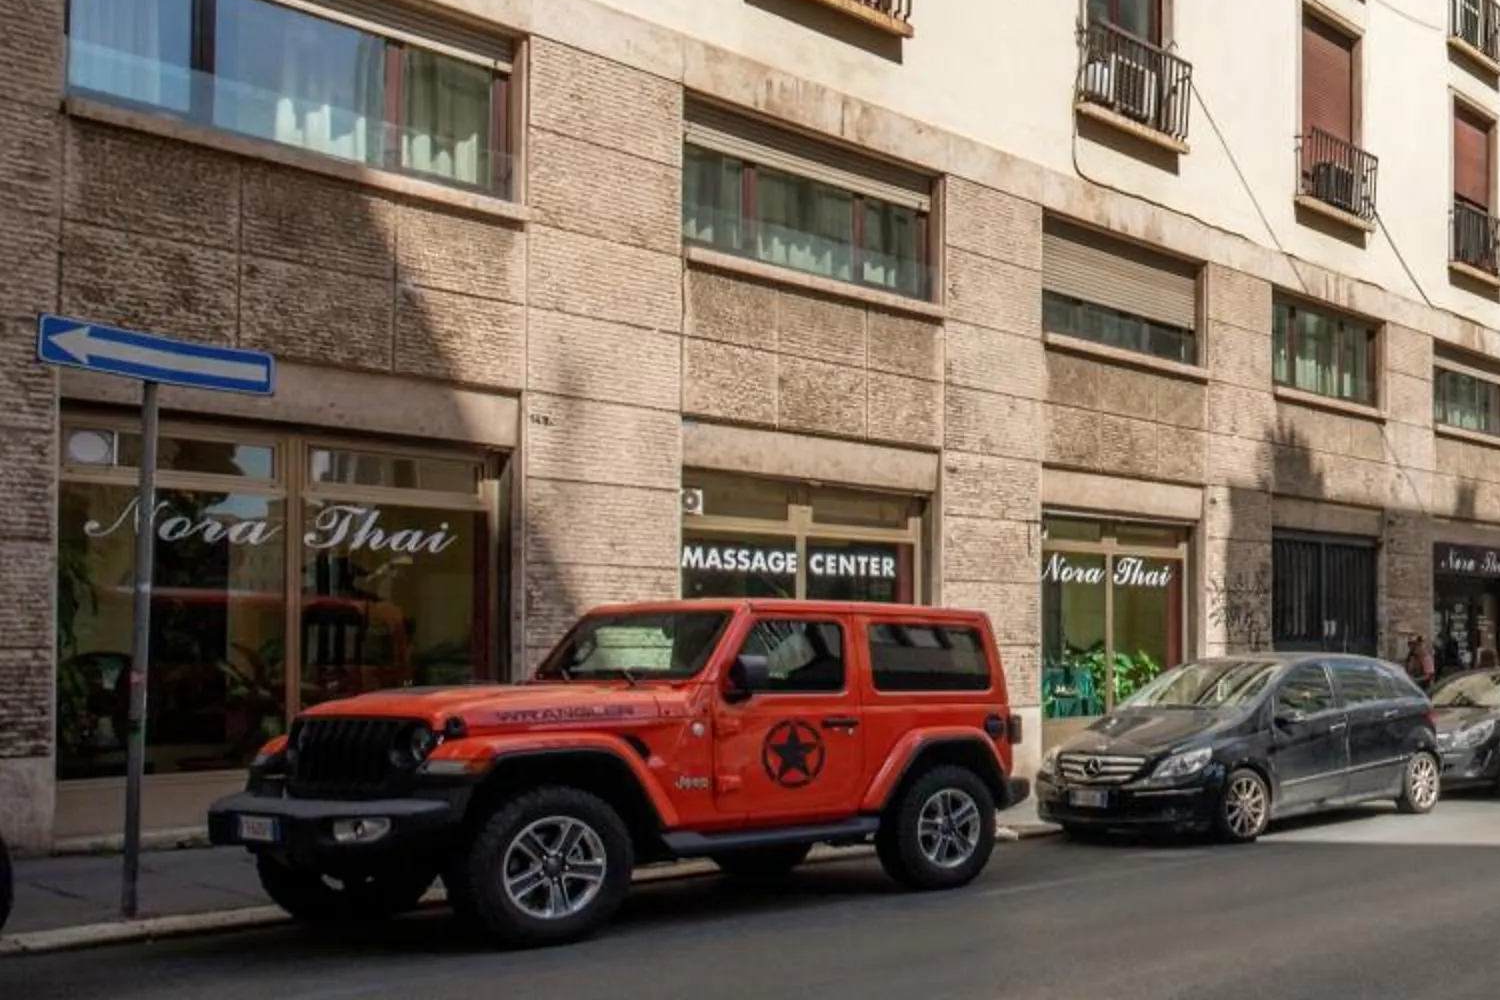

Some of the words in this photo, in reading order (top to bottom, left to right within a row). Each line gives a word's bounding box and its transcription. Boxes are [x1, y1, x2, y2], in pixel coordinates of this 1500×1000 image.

[83, 495, 281, 546] Nora
[303, 503, 458, 554] Thai
[681, 544, 799, 574] MASSAGE
[809, 553, 896, 578] CENTER
[1040, 551, 1105, 584] Nora
[1113, 556, 1172, 587] Thai
[496, 704, 635, 722] WRANGLER
